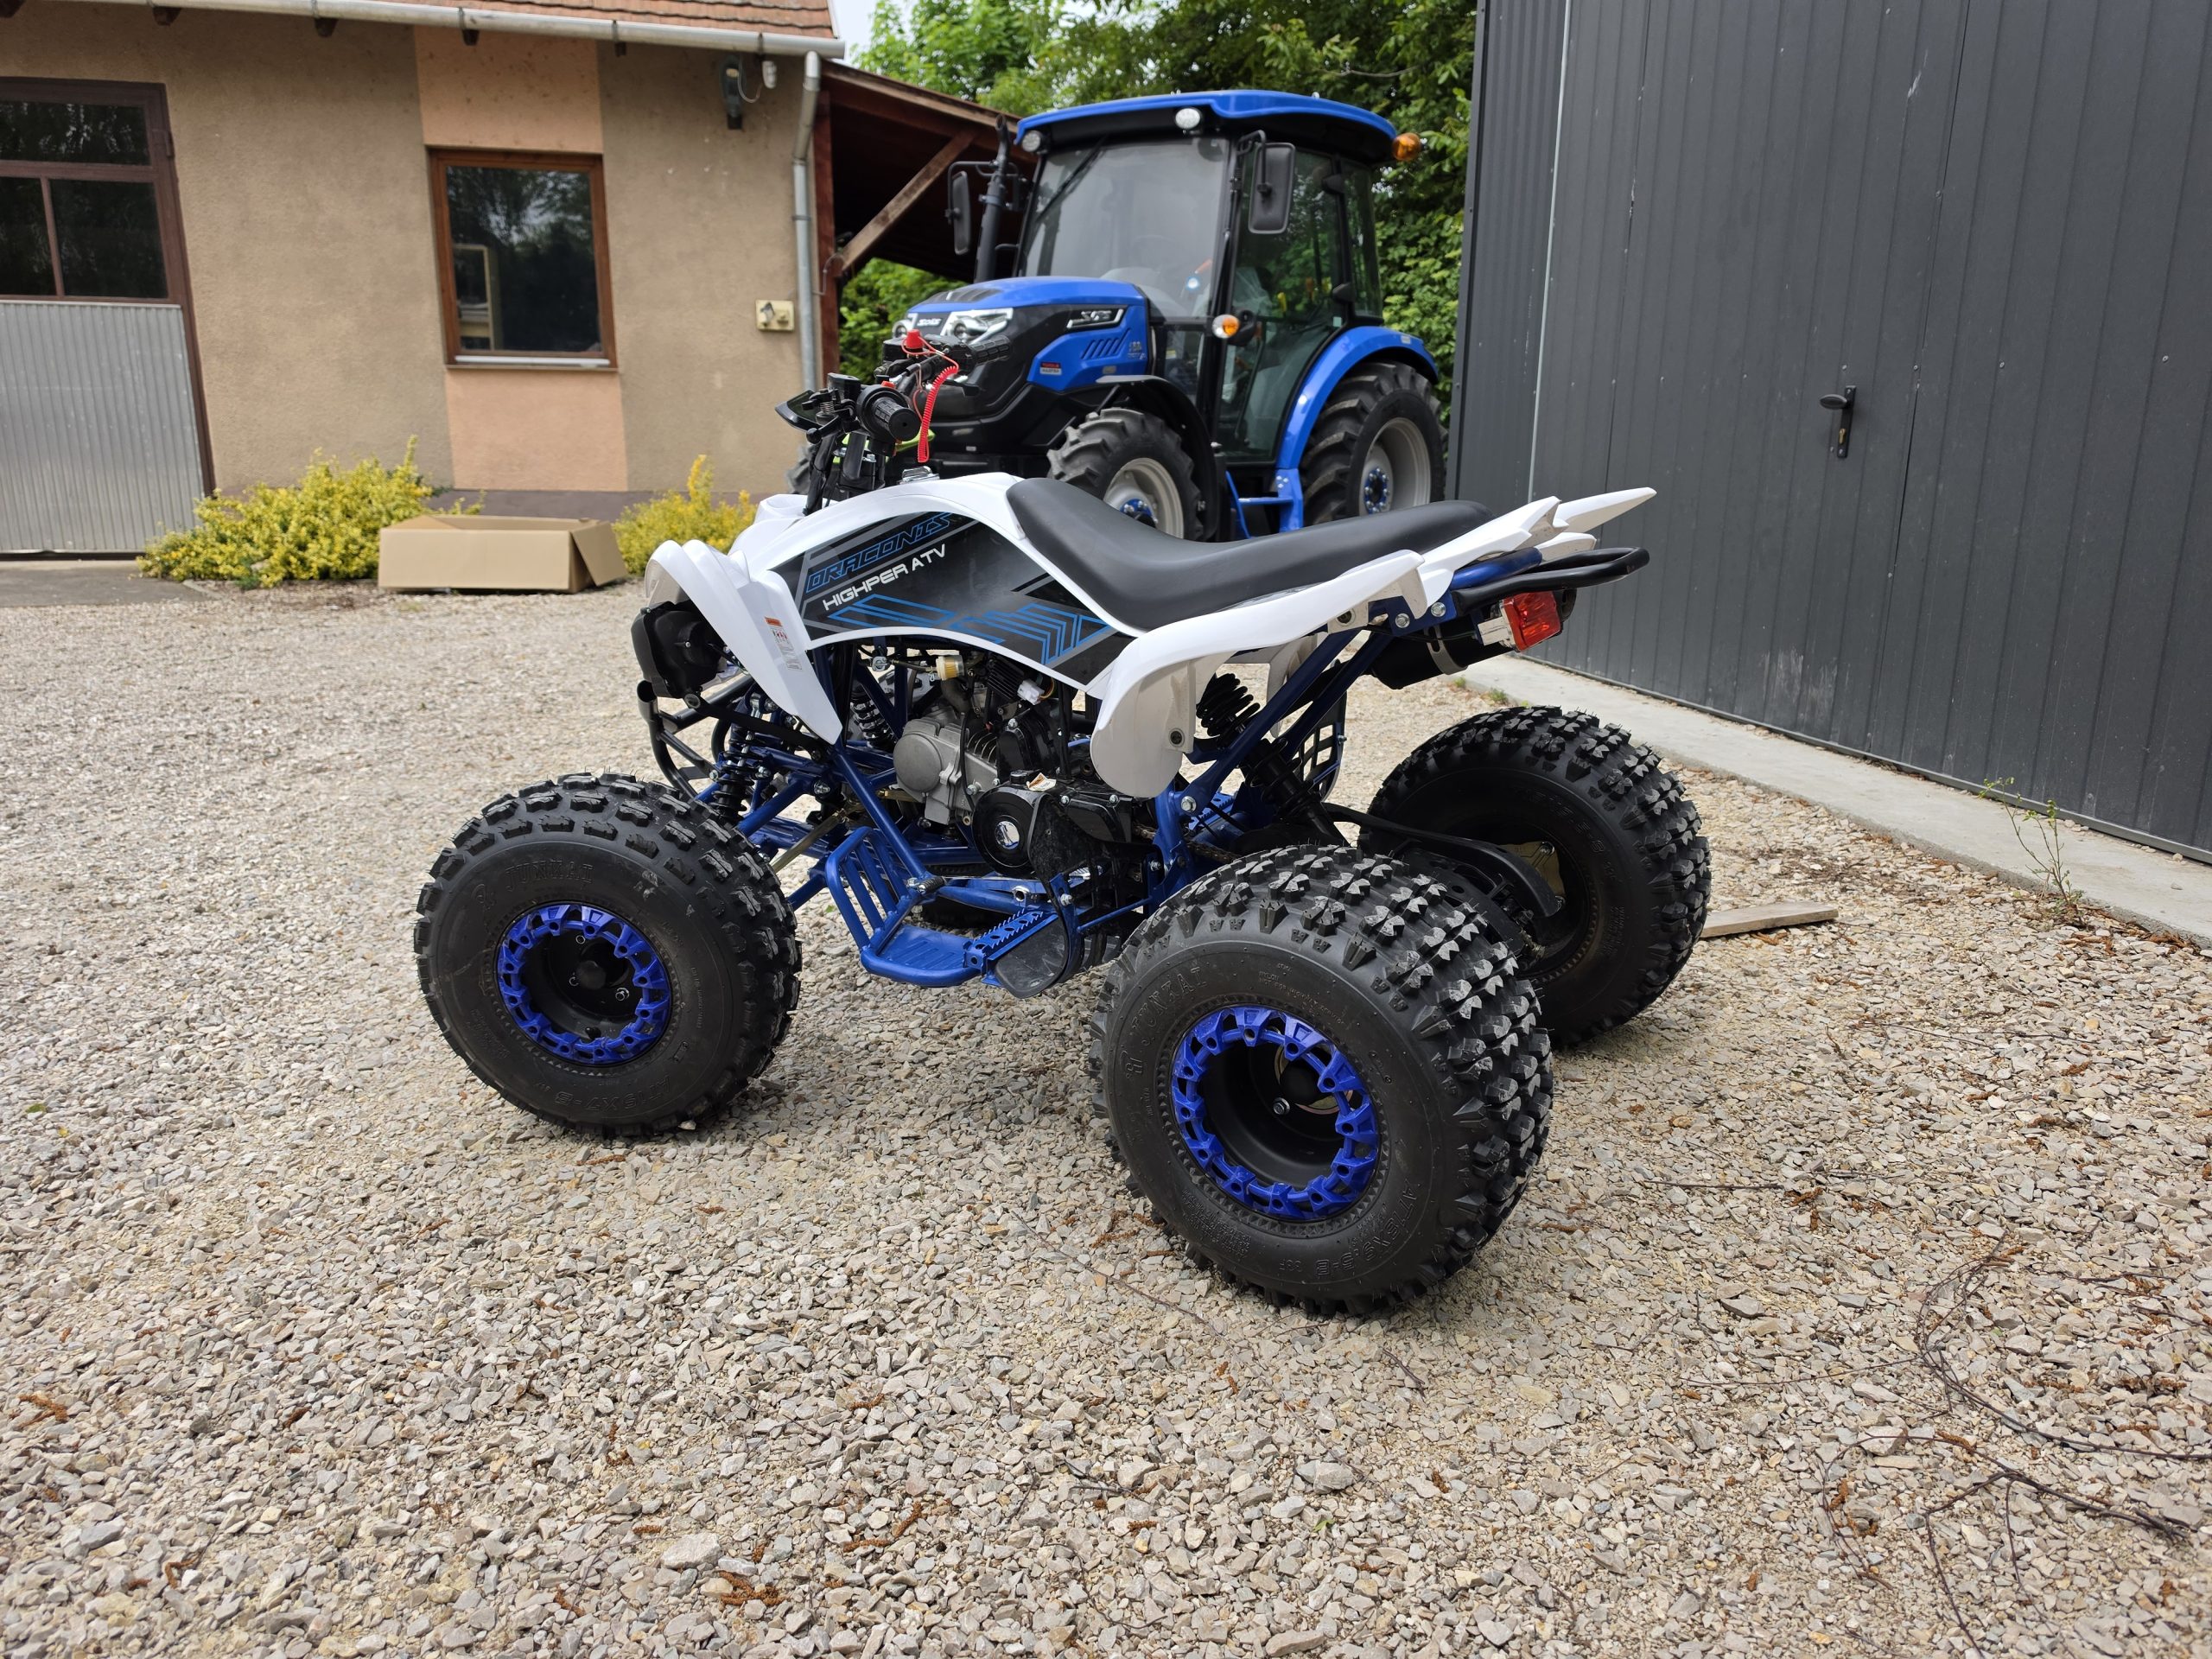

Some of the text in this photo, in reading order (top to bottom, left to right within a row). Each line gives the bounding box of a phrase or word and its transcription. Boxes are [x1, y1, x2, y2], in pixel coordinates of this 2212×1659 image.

[805, 512, 952, 594] DRACONIS
[823, 543, 946, 611] HIGHPER ATV
[504, 858, 594, 893] JUNKAI
